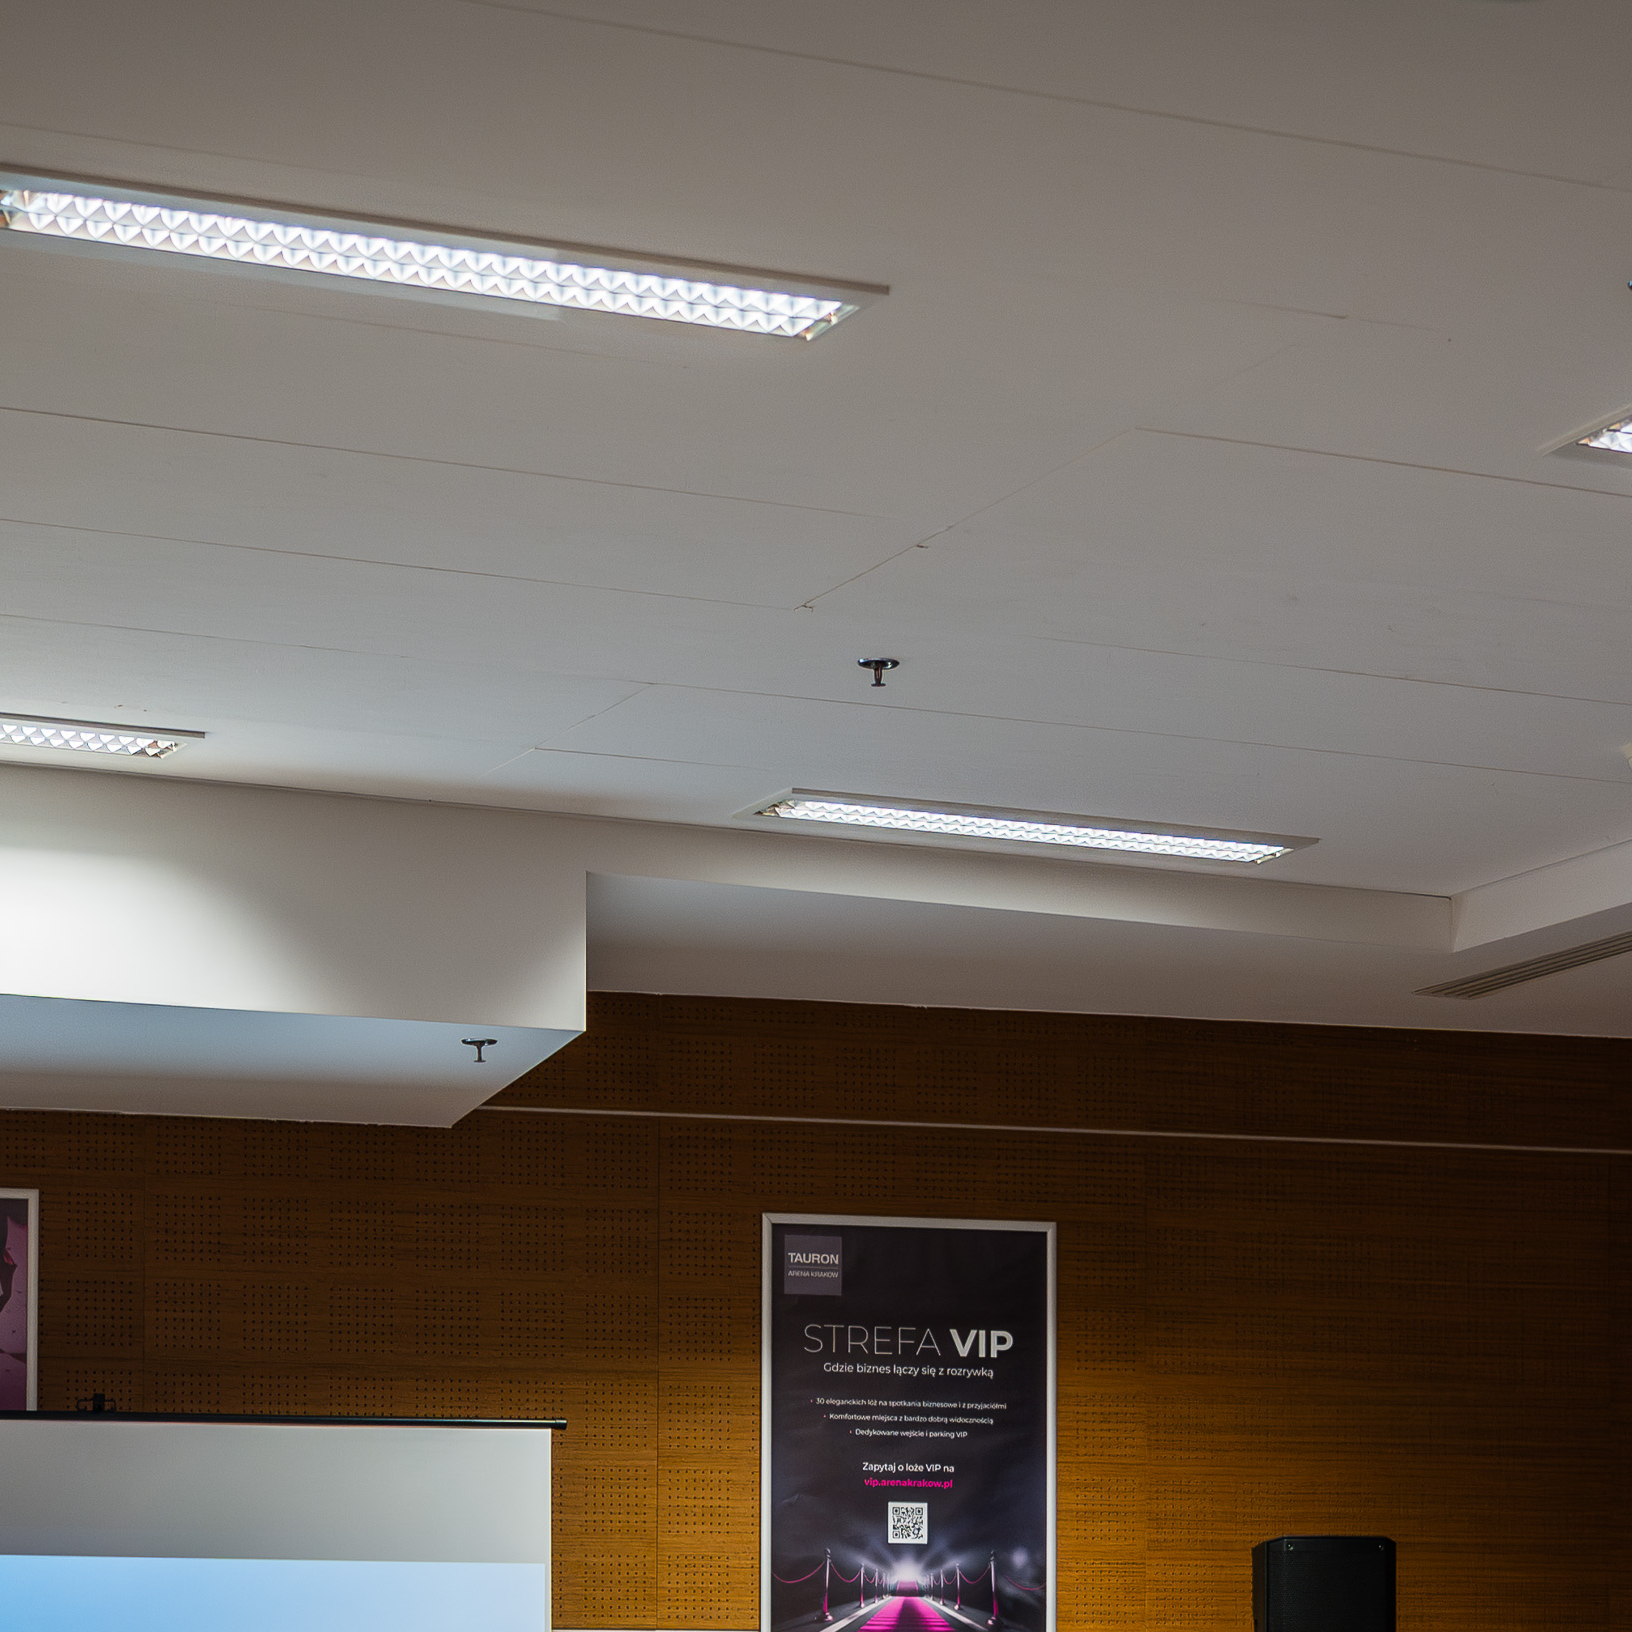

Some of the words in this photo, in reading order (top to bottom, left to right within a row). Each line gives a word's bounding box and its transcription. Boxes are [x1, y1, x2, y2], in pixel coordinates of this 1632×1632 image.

[787, 1252, 839, 1265] TAURON
[804, 1323, 942, 1357] STREFA
[949, 1328, 1014, 1359] VIP
[823, 1362, 854, 1373] Gdzie
[856, 1363, 891, 1374] biznes
[893, 1364, 920, 1377] łączy
[921, 1364, 937, 1377] się
[938, 1367, 945, 1376] z
[946, 1366, 994, 1380] rozrywką
[816, 1397, 825, 1405] 30
[889, 1399, 921, 1408] spotkania
[829, 1413, 871, 1421] Komfortowe
[872, 1413, 898, 1422] miejsca
[904, 1414, 927, 1422] bardzo
[855, 1428, 899, 1437] Dedykowane
[929, 1430, 955, 1439] parking
[862, 1461, 896, 1474] Zapytaj
[897, 1464, 904, 1472] o
[925, 1463, 941, 1472] VIP
[943, 1465, 955, 1473] na
[864, 1477, 953, 1490] vip.arenakrakow.pl
